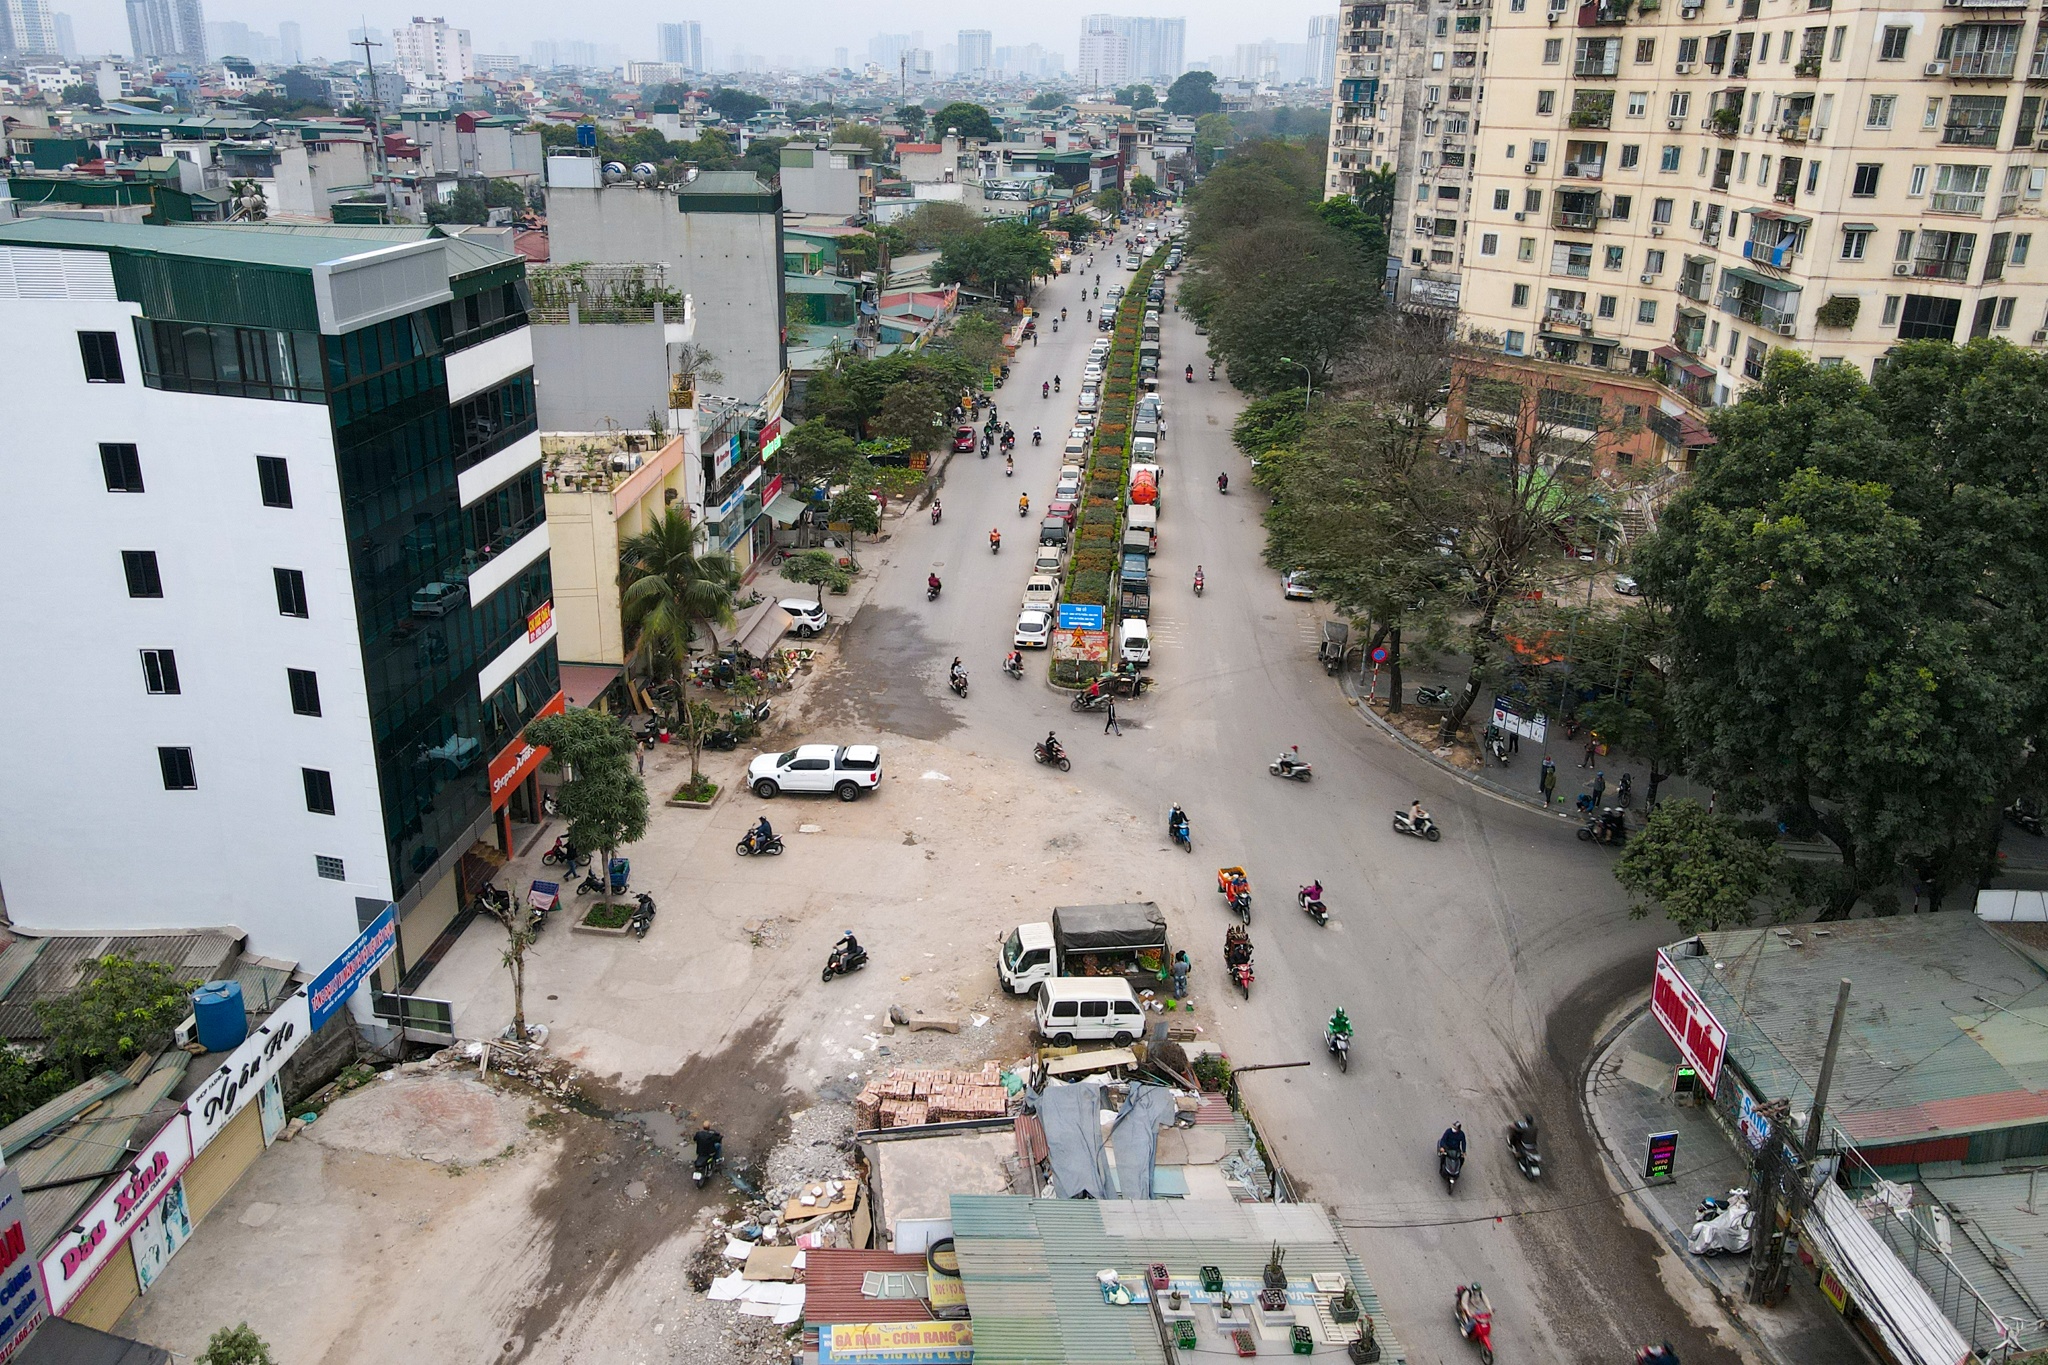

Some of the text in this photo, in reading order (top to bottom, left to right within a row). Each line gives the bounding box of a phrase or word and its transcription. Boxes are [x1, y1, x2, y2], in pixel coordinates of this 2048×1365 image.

[493, 766, 516, 794] Shopee
[203, 1055, 262, 1126] Ngân
[835, 1331, 853, 1347] GÀ
[855, 1331, 881, 1346] RÁN
[892, 1331, 921, 1345] CƠM
[923, 1330, 957, 1344] RANG
